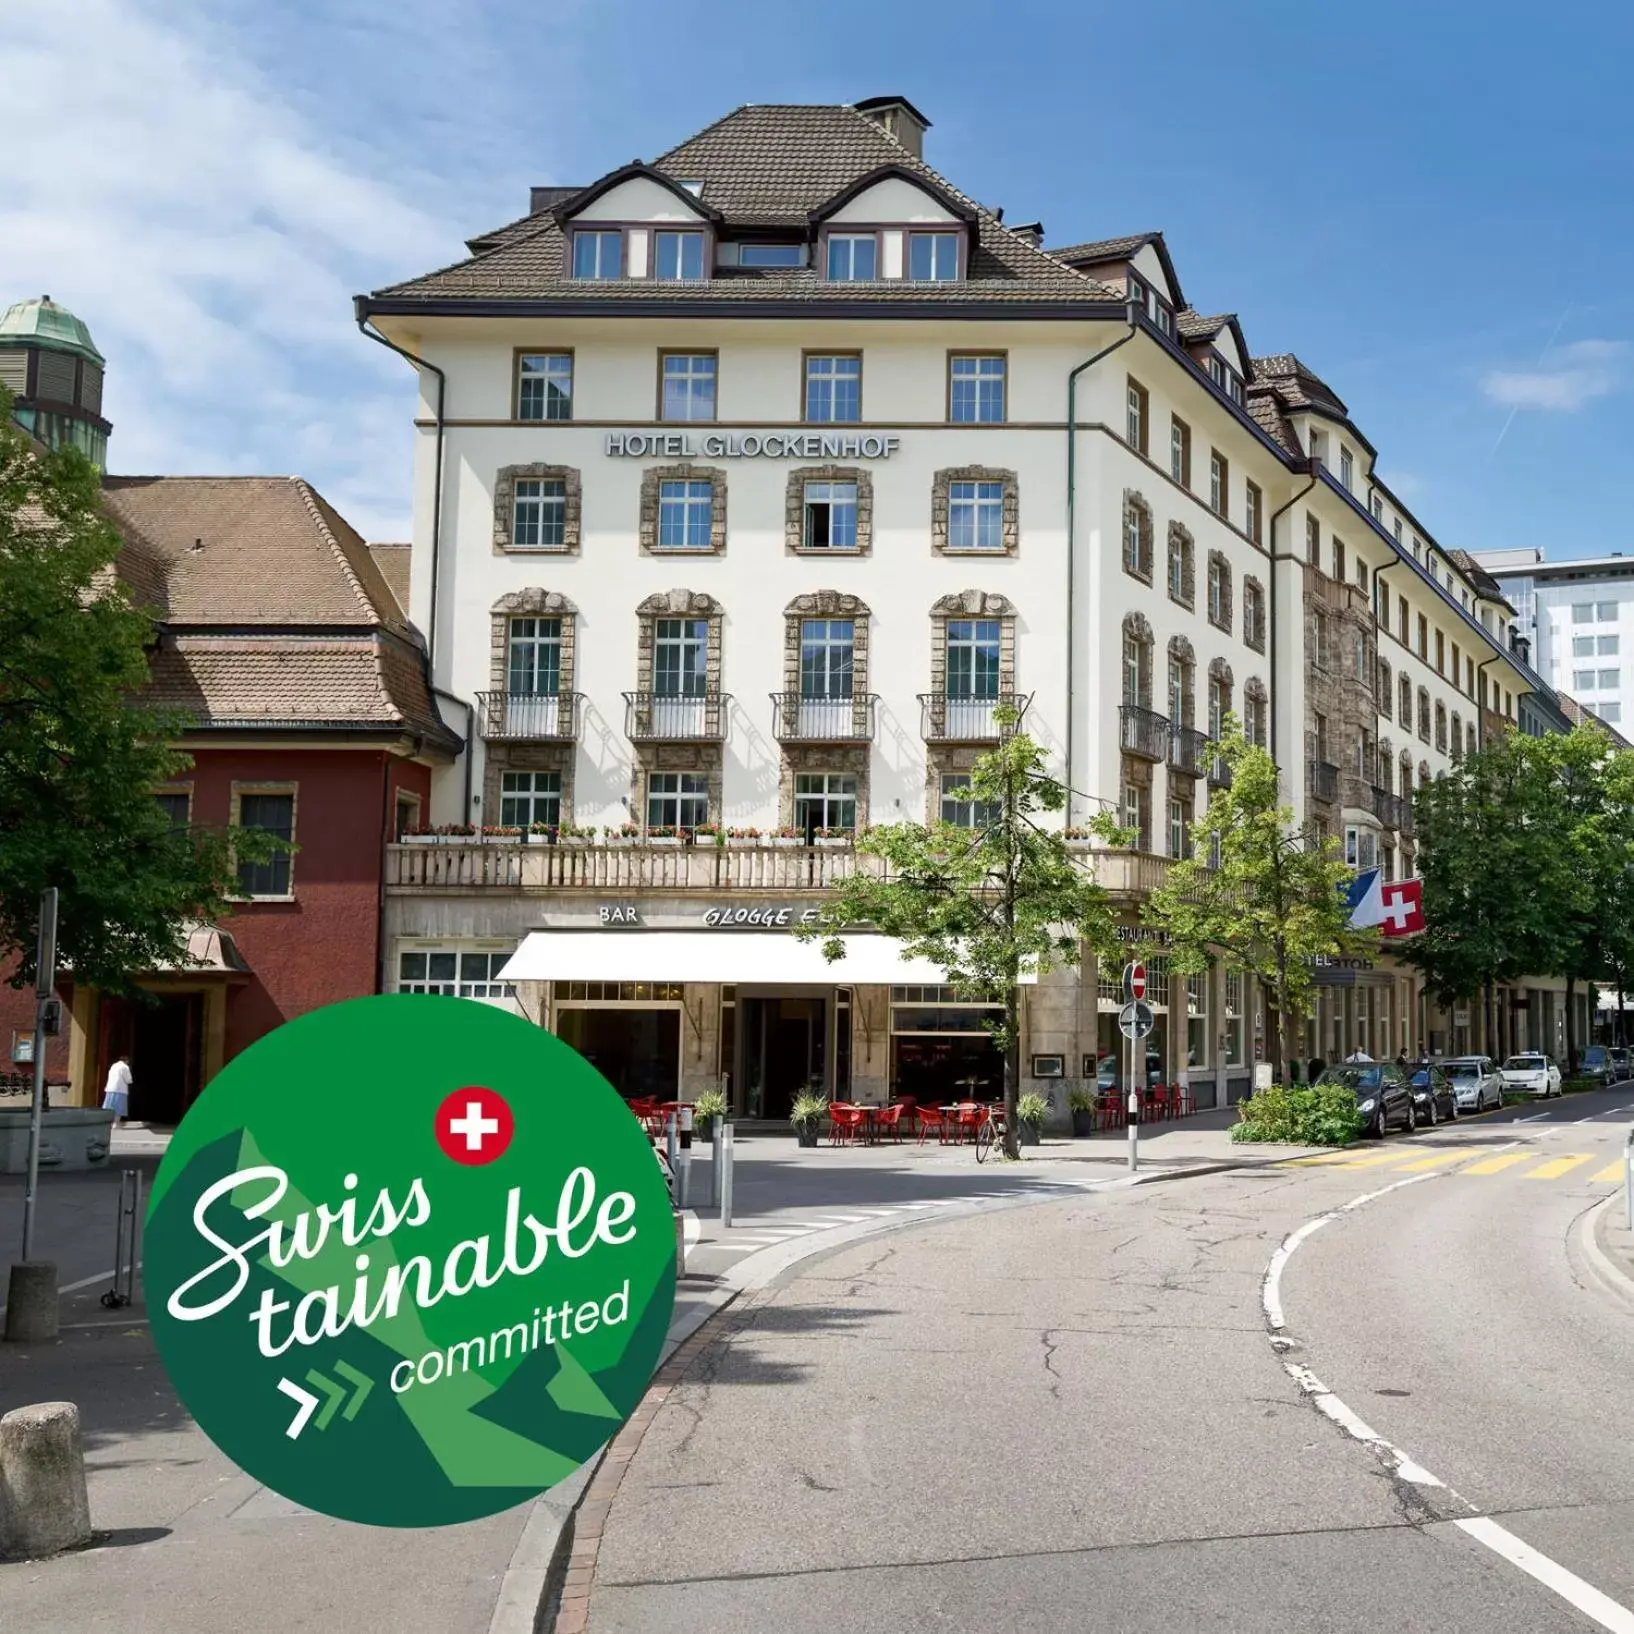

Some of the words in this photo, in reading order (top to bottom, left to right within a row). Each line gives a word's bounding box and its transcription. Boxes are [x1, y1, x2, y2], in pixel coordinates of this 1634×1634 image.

[606, 433, 697, 457] HOTEL
[703, 435, 900, 458] GLOCKENHOF
[599, 906, 638, 923] BAR
[703, 907, 793, 927] GLOGGE
